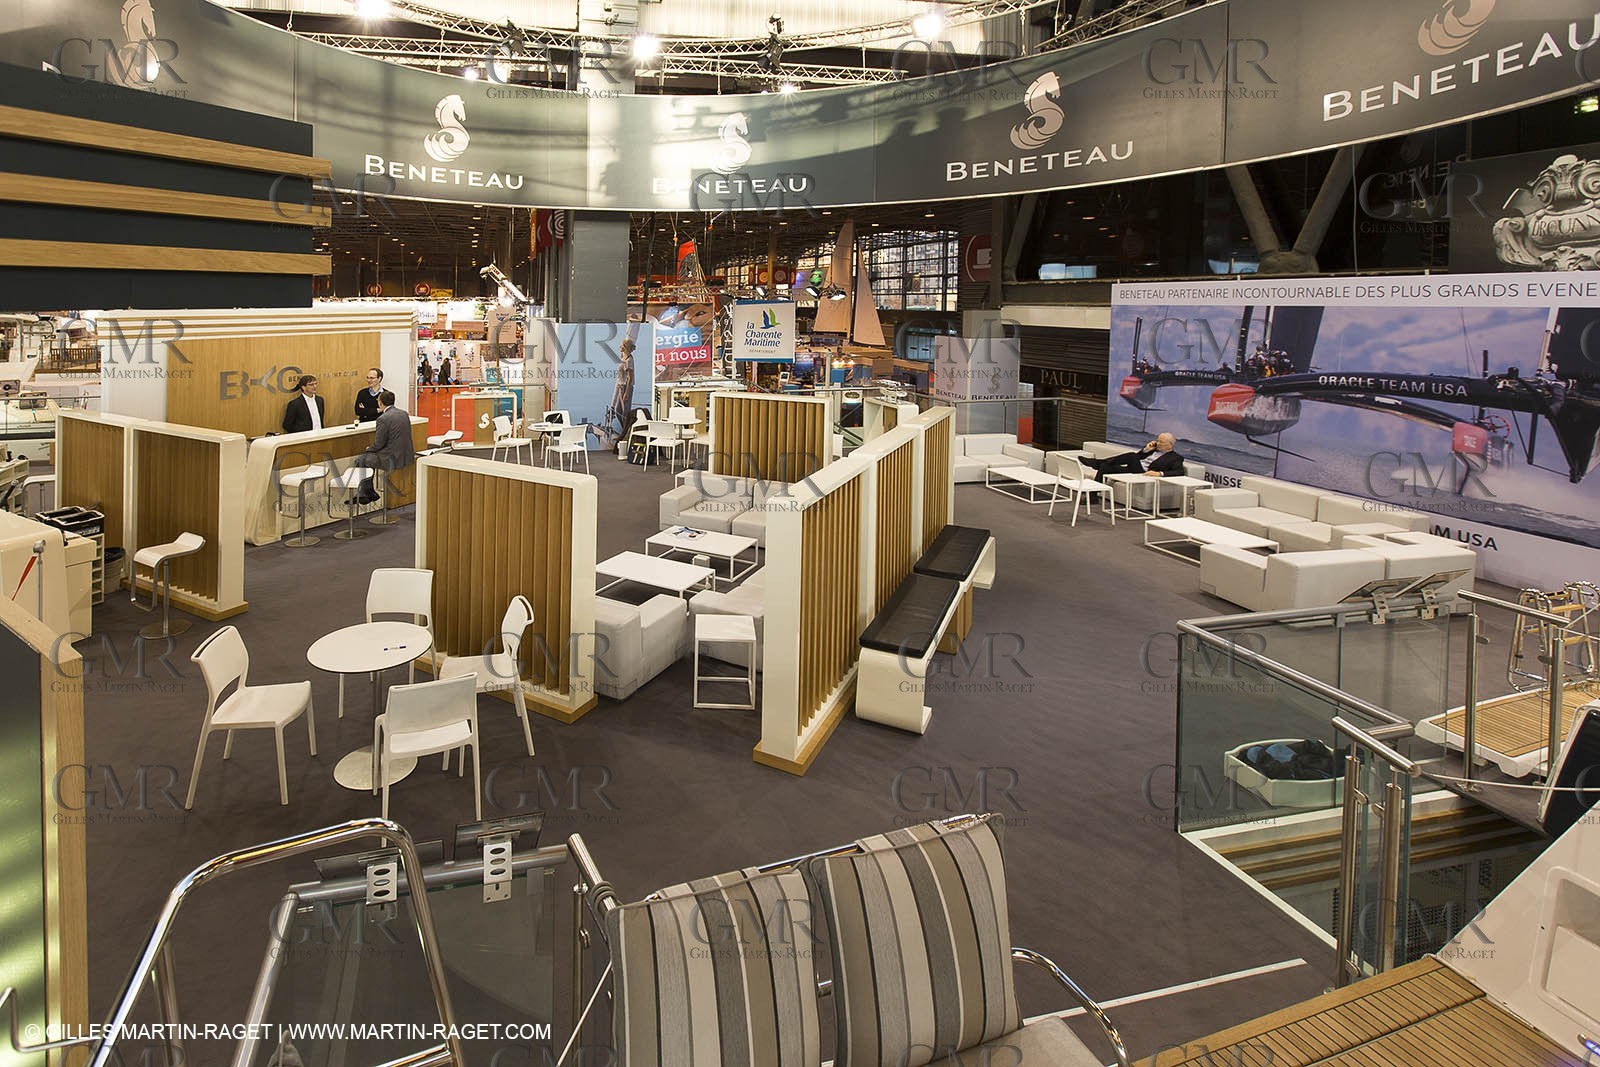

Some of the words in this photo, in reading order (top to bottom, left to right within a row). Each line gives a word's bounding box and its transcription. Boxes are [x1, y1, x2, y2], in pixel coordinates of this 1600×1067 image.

[1323, 12, 1600, 122] BENETEAU
[946, 140, 1134, 182] BENETEAU
[365, 154, 524, 190] BENETEAU
[652, 177, 807, 194] BENETEAU
[1119, 289, 1166, 299] BENETEAU
[1167, 288, 1229, 299] PARTENAIRE
[1232, 286, 1350, 299] INCONTOURNABLE
[1355, 285, 1385, 298] DES
[1390, 284, 1432, 298] PLUS
[1437, 283, 1520, 298] GRANDS
[1526, 282, 1598, 297] EVENE
[745, 330, 782, 339] Charente
[746, 321, 755, 330] la
[656, 329, 699, 348] ergie
[744, 338, 781, 347] Maritime
[669, 350, 708, 362] nous
[1040, 368, 1083, 389] PAUL
[1319, 375, 1375, 388] ORACLE
[1380, 378, 1425, 393] TEAM
[1432, 382, 1468, 397] USA
[935, 388, 967, 401] BENETEAU
[1458, 529, 1498, 551] USA
